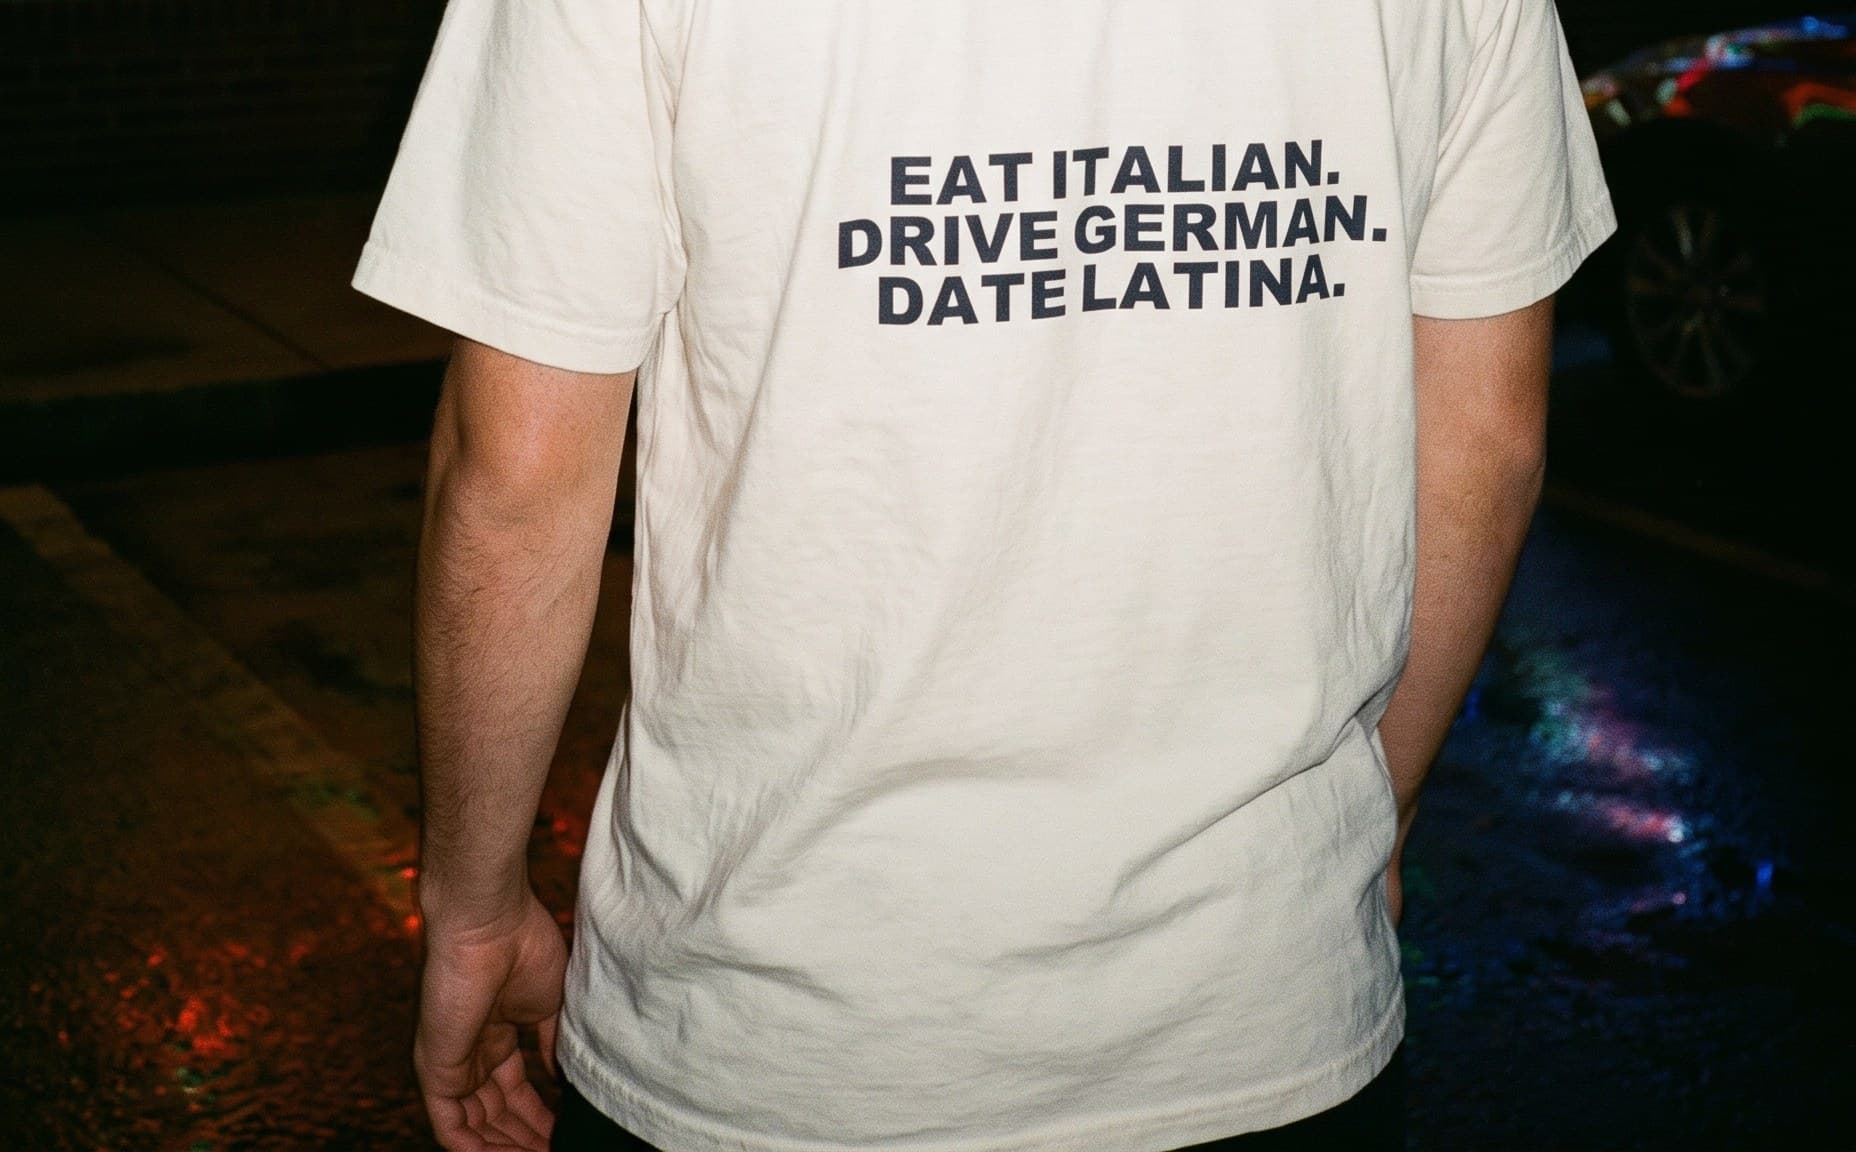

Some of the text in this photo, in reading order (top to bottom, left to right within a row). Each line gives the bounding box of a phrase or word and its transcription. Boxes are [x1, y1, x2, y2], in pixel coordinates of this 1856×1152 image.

[890, 139, 1340, 205] EAT ITALIAN.
[838, 194, 1387, 269] DRIVE GERMAN.
[878, 253, 1346, 326] DATE LATINA.
